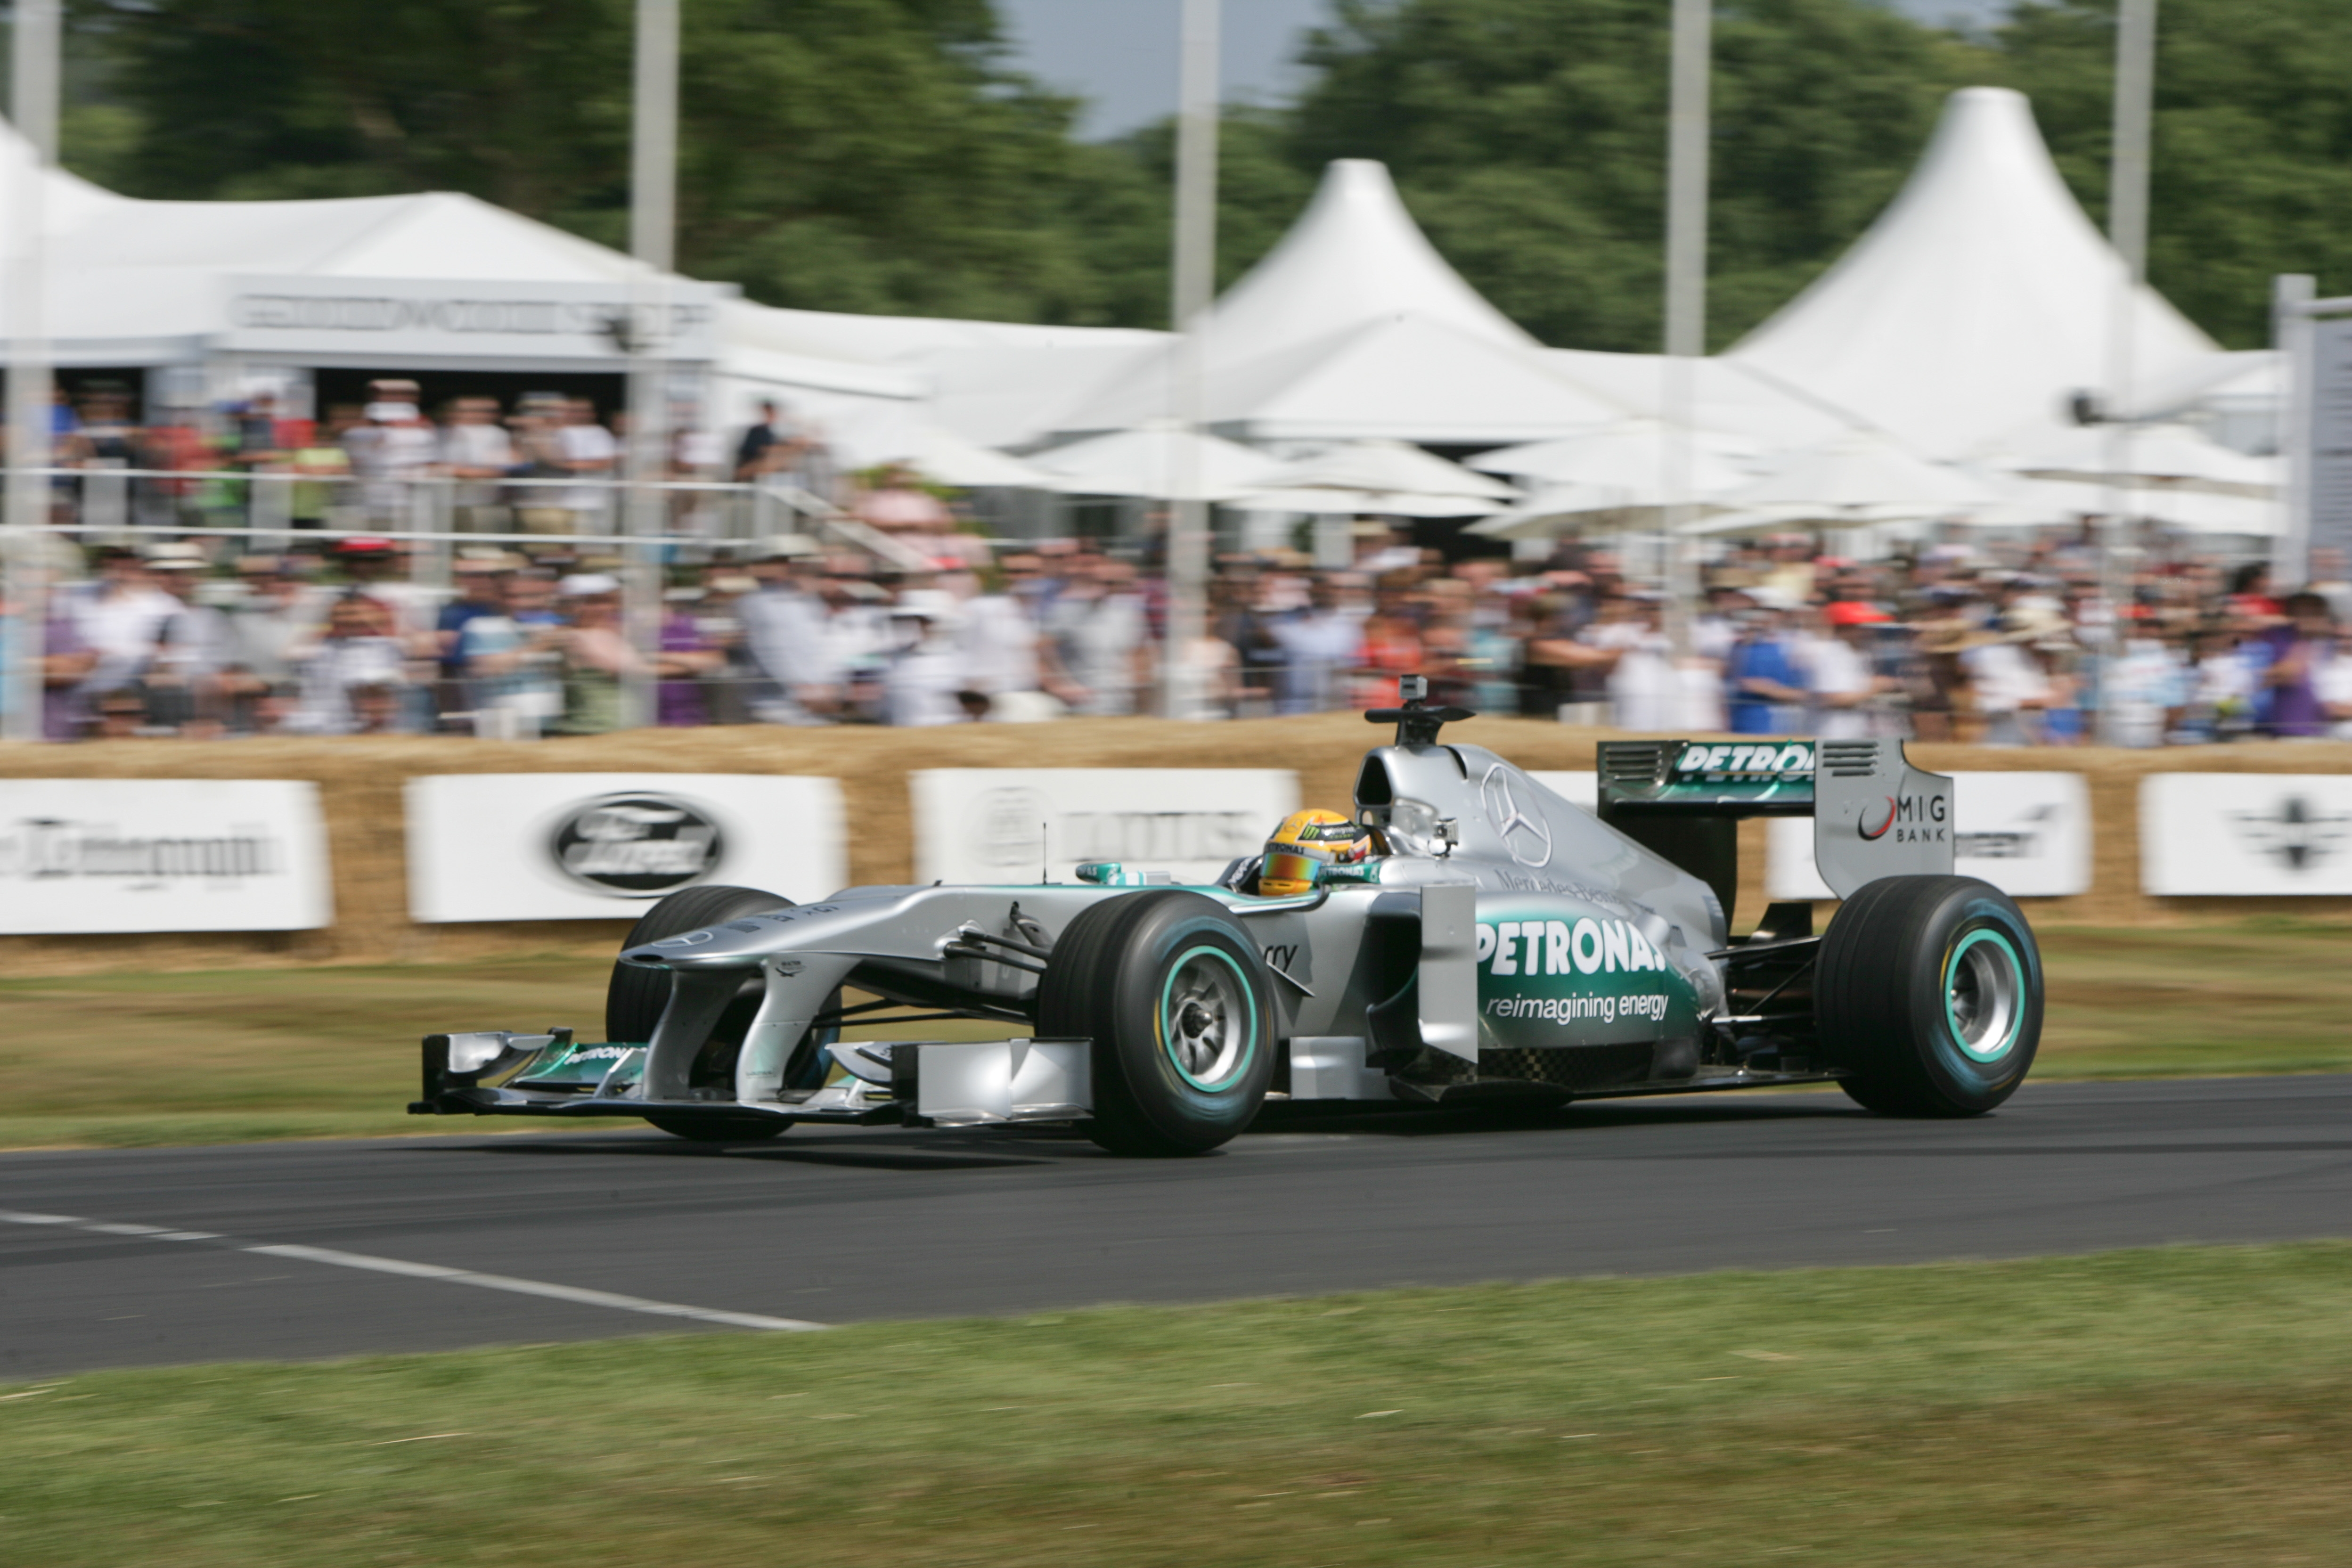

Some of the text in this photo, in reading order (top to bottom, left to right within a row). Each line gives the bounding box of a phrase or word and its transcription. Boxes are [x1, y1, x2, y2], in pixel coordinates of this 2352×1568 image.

[1897, 795, 1944, 822] MIG
[1897, 829, 1944, 842] BANK
[1486, 992, 1668, 1025] reimagining energy
